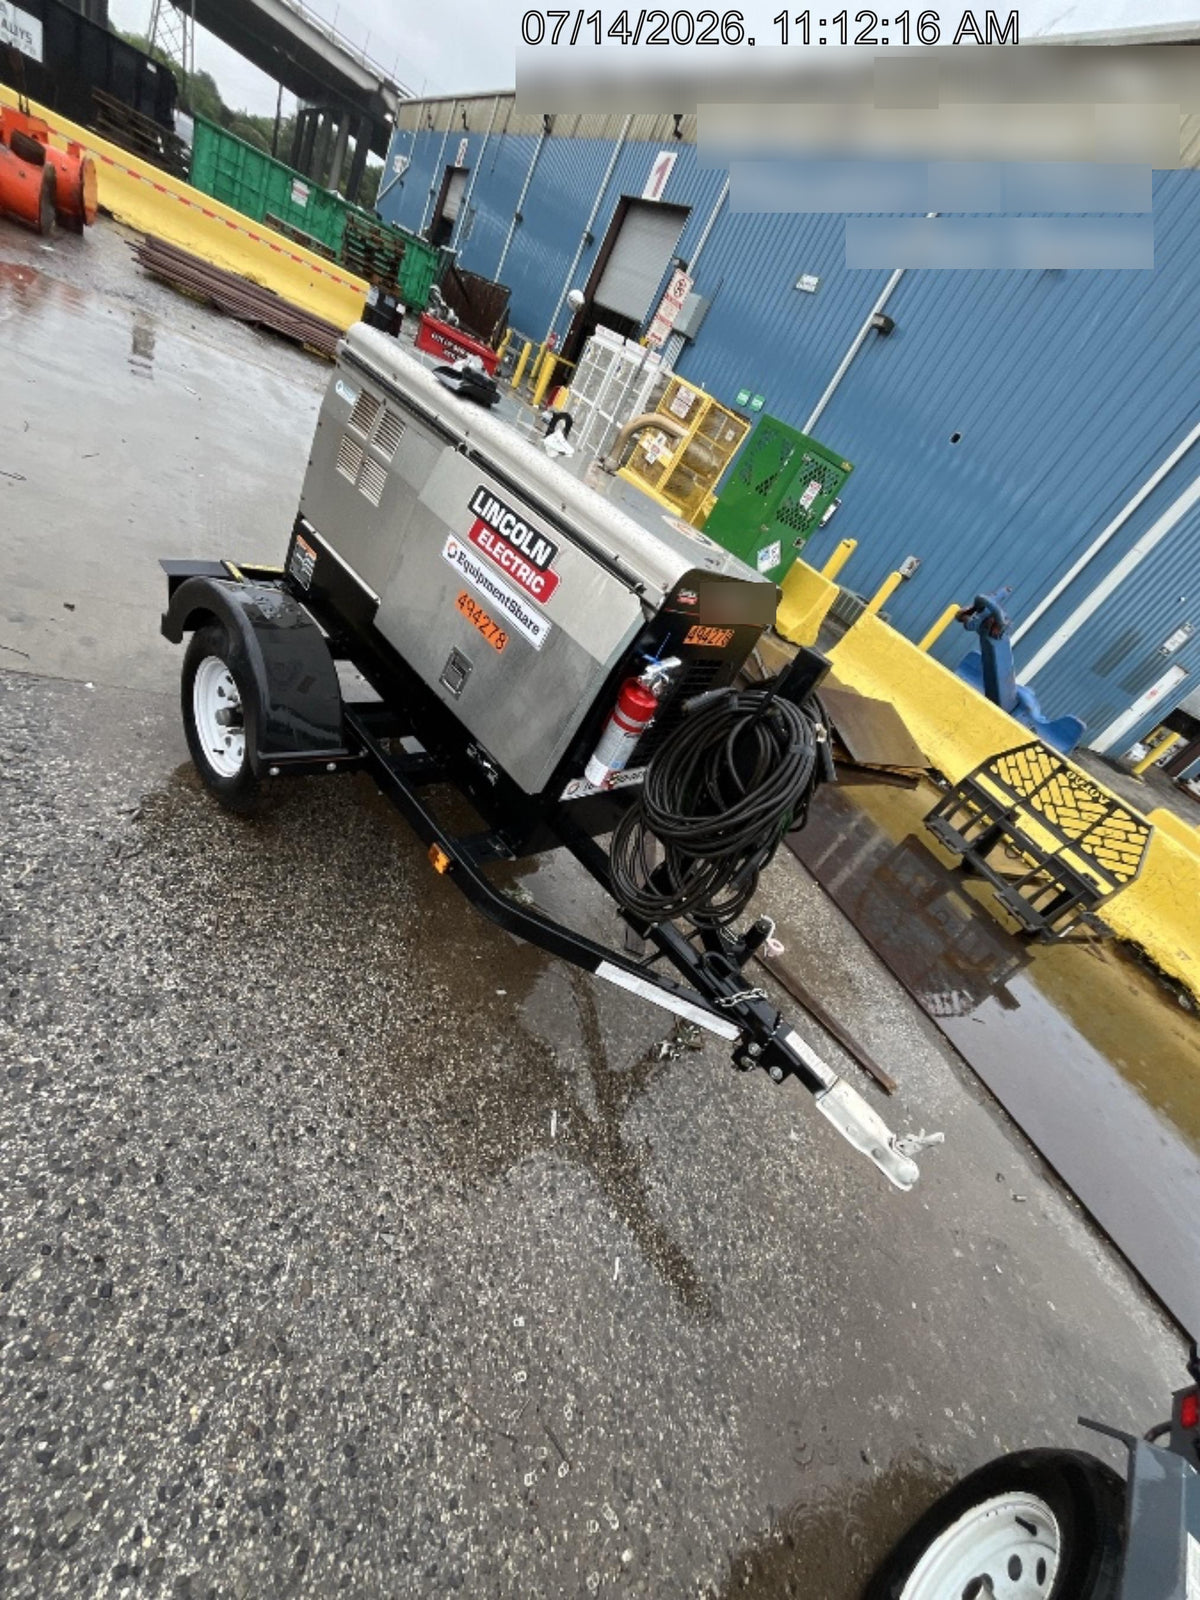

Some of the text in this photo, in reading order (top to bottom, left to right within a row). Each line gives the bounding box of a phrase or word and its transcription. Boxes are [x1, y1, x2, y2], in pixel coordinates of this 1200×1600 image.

[652, 156, 672, 198] 1
[472, 490, 552, 567] LINCOLN
[477, 528, 545, 594] ELECTRIC
[456, 551, 541, 636] EquipmentShare
[457, 592, 507, 650] 494278
